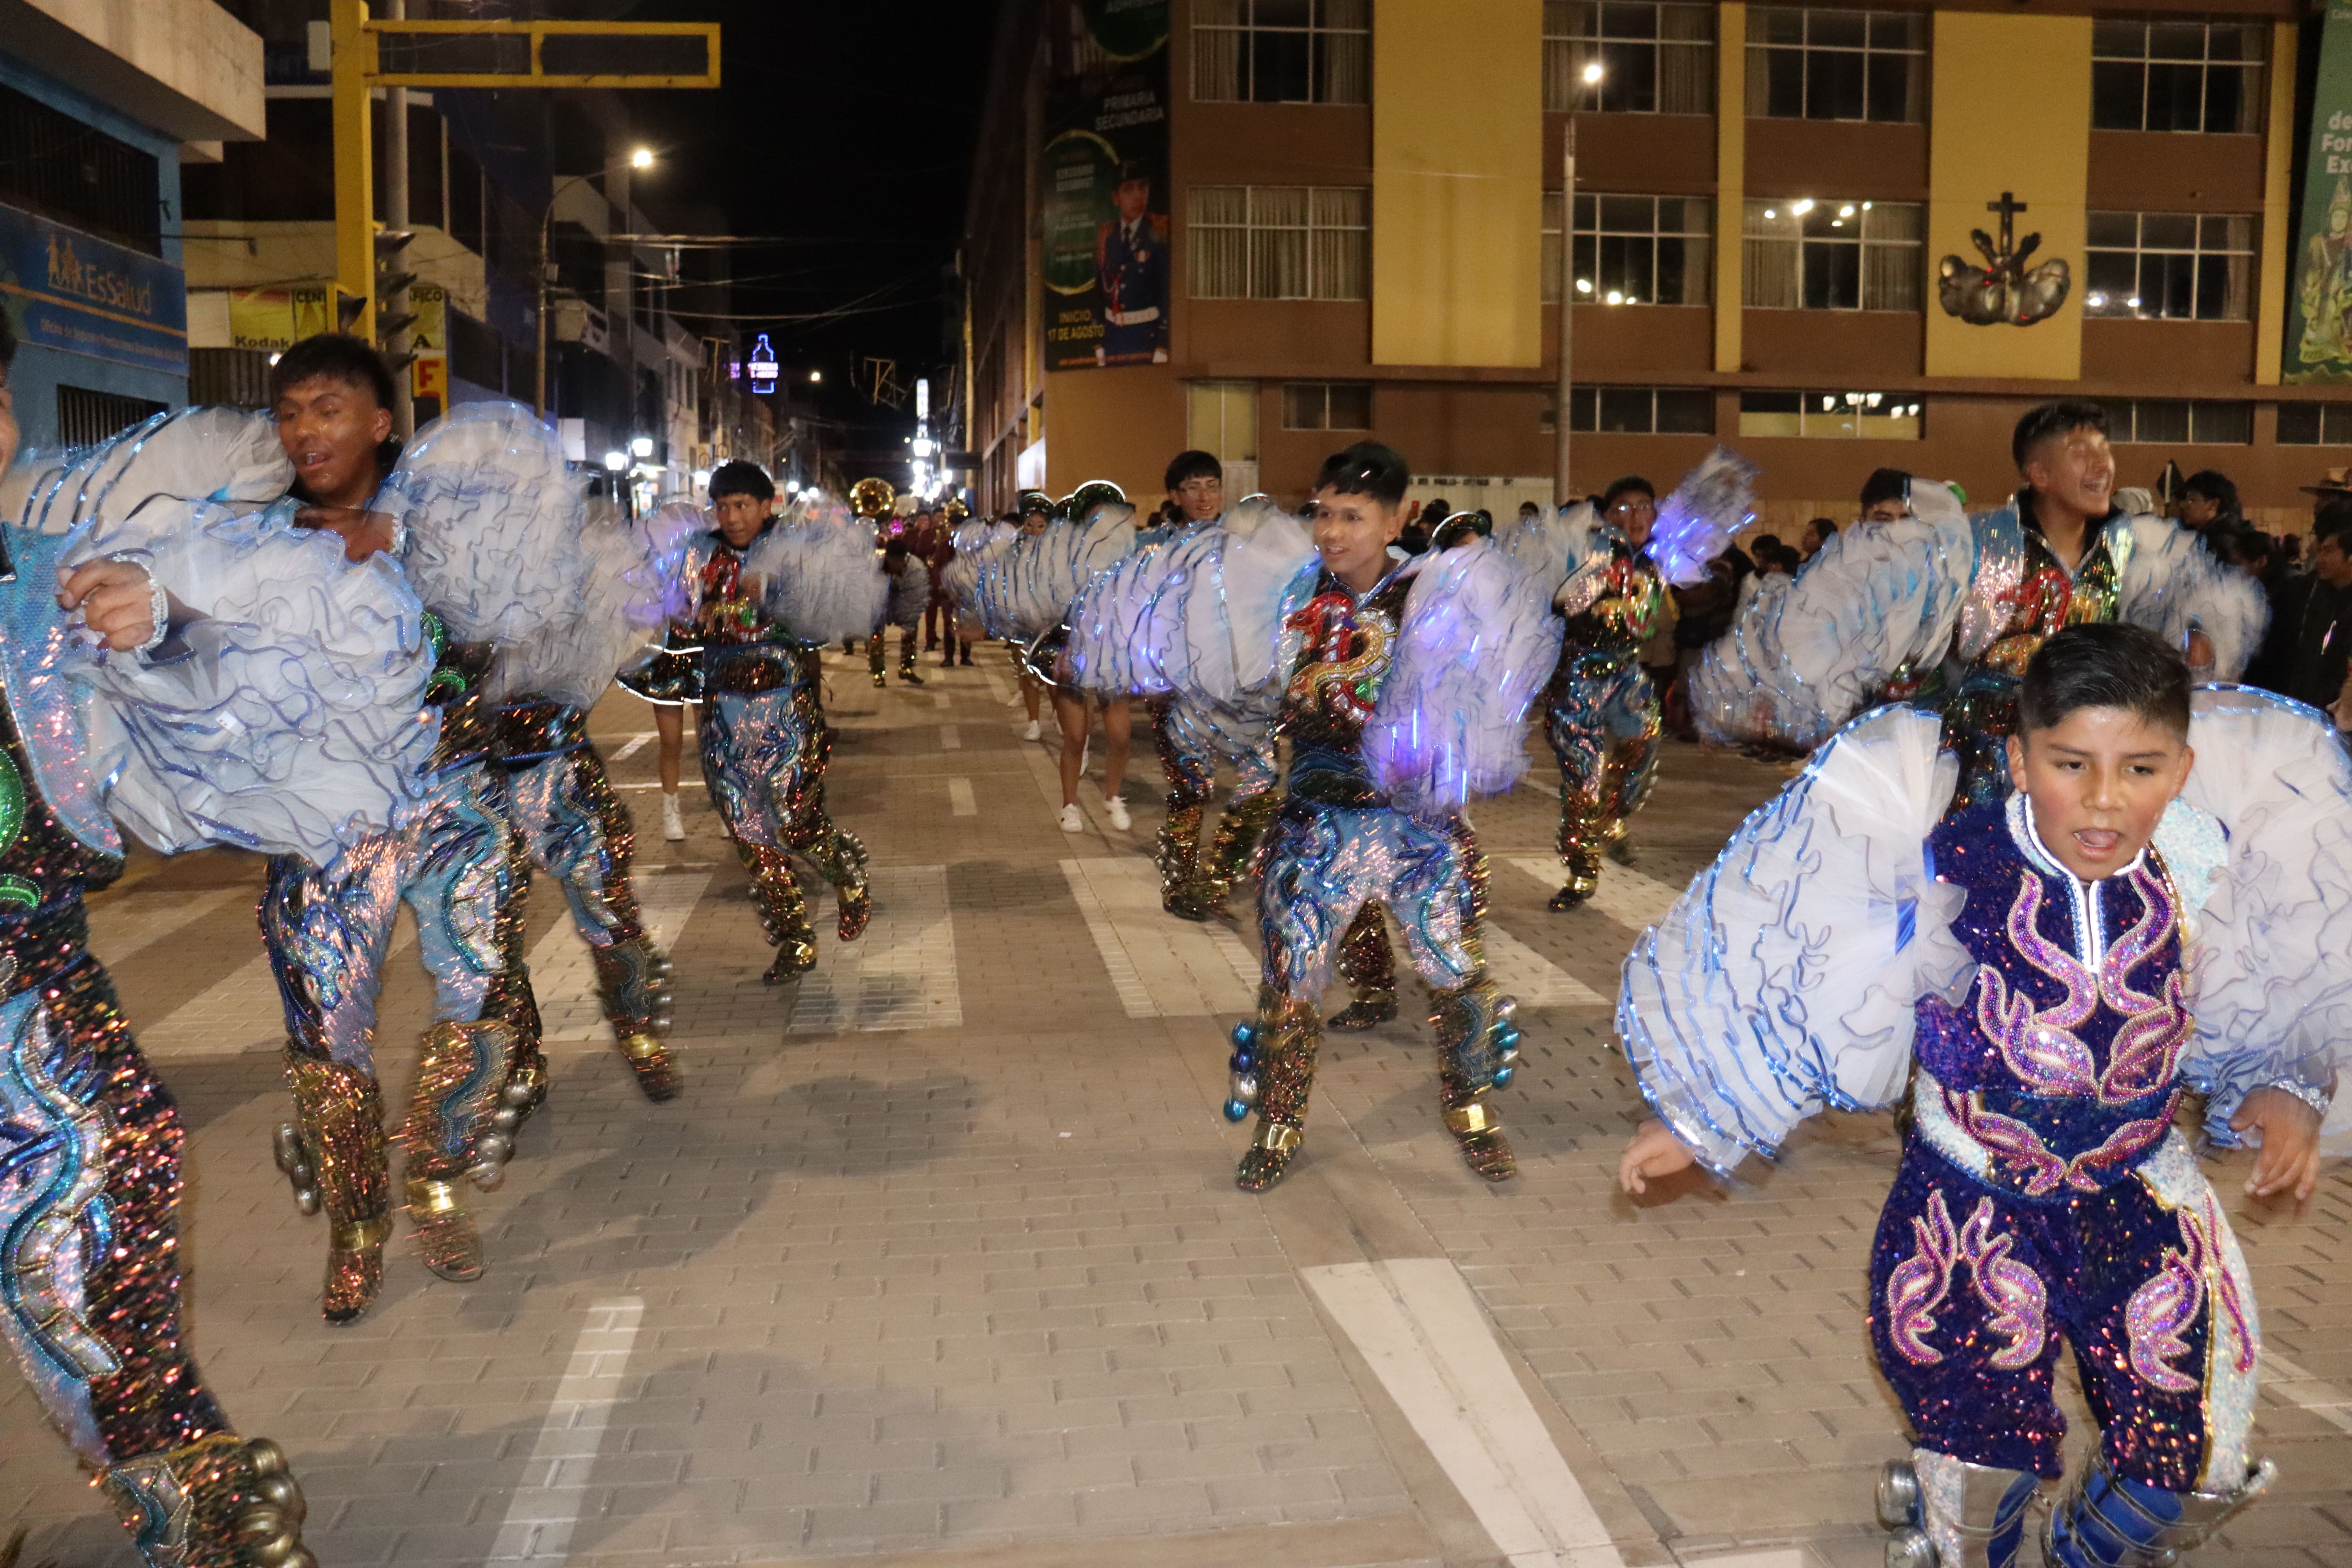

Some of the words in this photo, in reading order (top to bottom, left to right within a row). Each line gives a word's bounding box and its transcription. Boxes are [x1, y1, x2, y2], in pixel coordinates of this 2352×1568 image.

[1095, 106, 1164, 131] SECUNDARIA
[2326, 156, 2352, 173] Ex
[86, 263, 152, 315] EsSalud
[1059, 309, 1092, 323] INICIO
[1058, 327, 1070, 340] DE
[1071, 324, 1105, 339] AGOSTO
[236, 336, 290, 348] Kodak
